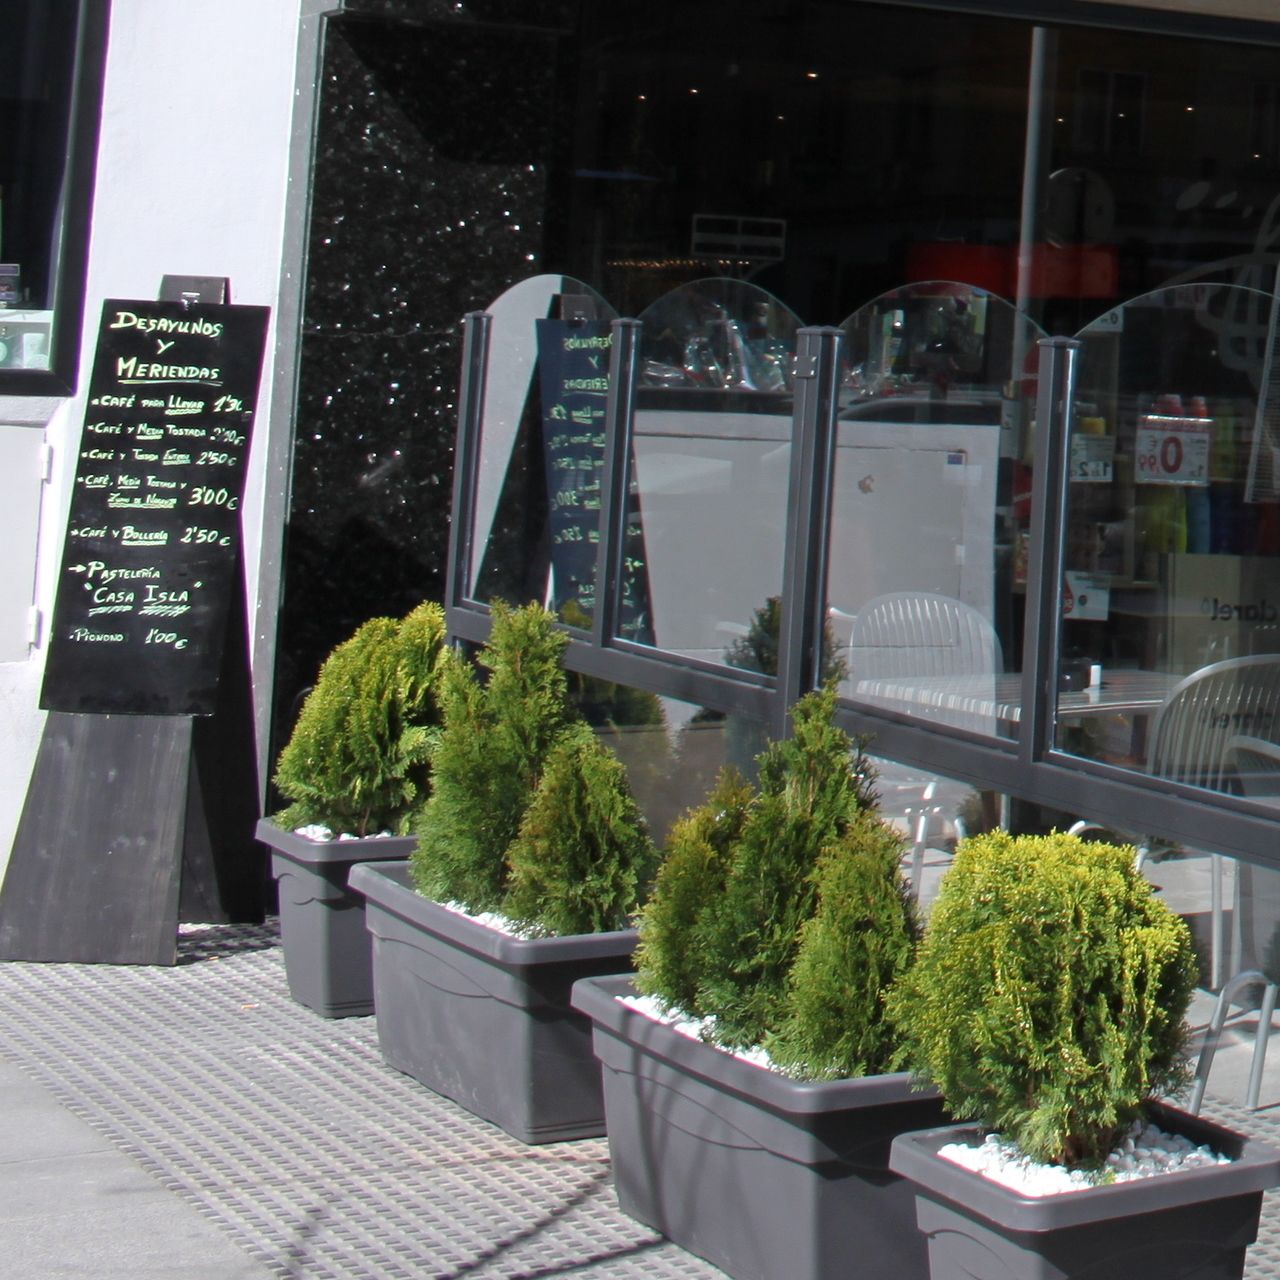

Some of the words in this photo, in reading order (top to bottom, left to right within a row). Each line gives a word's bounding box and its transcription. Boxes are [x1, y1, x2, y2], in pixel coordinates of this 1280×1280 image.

[110, 311, 223, 338] DESAYUNOS
[157, 339, 175, 354] Y
[117, 356, 220, 380] MERIENDAS
[101, 394, 136, 408] CAFÉ
[95, 423, 122, 434] CAFÉ
[166, 424, 206, 437] TOSTADA
[89, 450, 114, 459] CAFÉ
[80, 526, 107, 538] CAFÉ
[88, 561, 160, 584] PASTELERÍA
